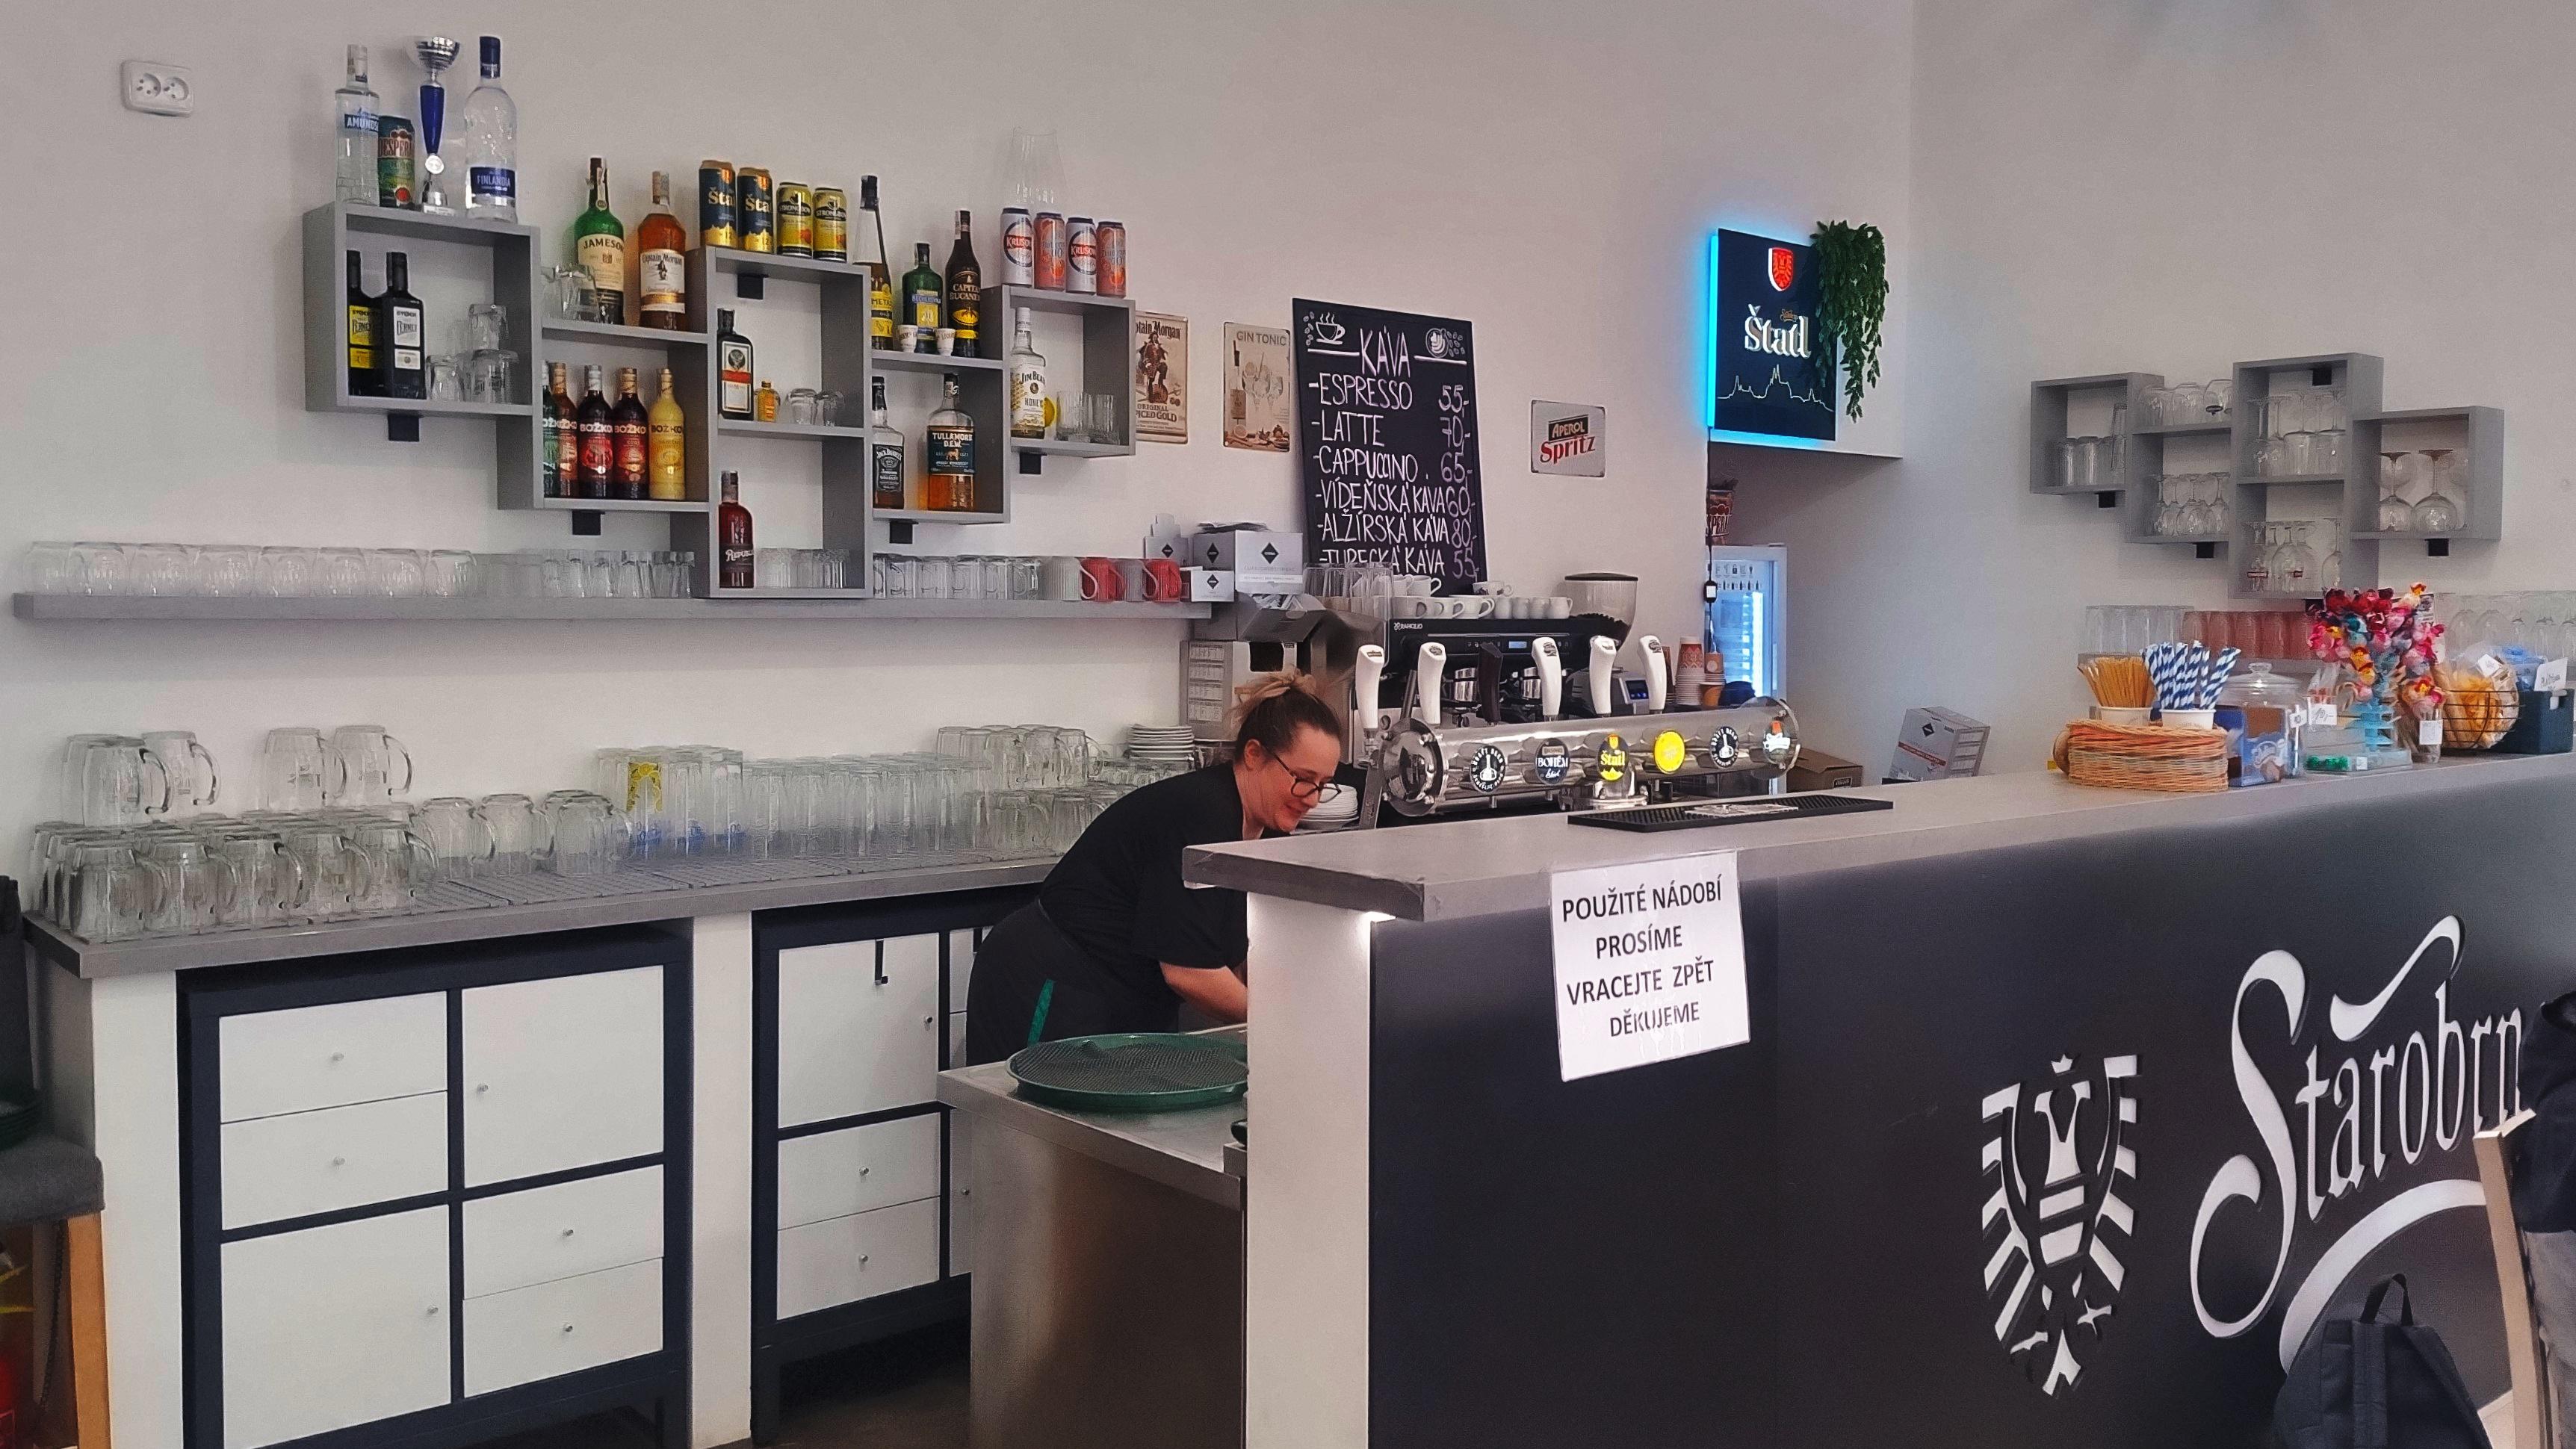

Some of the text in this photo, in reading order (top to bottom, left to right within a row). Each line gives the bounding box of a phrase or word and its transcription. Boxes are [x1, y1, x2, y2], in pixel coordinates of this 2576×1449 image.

[477, 174, 511, 187] FINLANDIA
[397, 320, 418, 336] FERNET
[1152, 320, 1180, 341] Morgan
[1236, 331, 1287, 346] GIN TONIC
[1360, 325, 1411, 378] KÁVA
[1137, 403, 1169, 412] ORIGINAL
[1157, 411, 1177, 422] GOLD
[1552, 421, 1585, 438] APEROL
[1540, 435, 1596, 465] Spritz
[1413, 513, 1449, 544] KÁVA
[1405, 544, 1446, 576] KÁVA
[1562, 873, 1723, 922] POUŽITÉ NÁDOBÍ
[1596, 923, 1683, 960] PROSÍME
[1566, 955, 1715, 1006] VRACEJTE ZPĚT
[1610, 1001, 1700, 1037] DĚKUJEME
